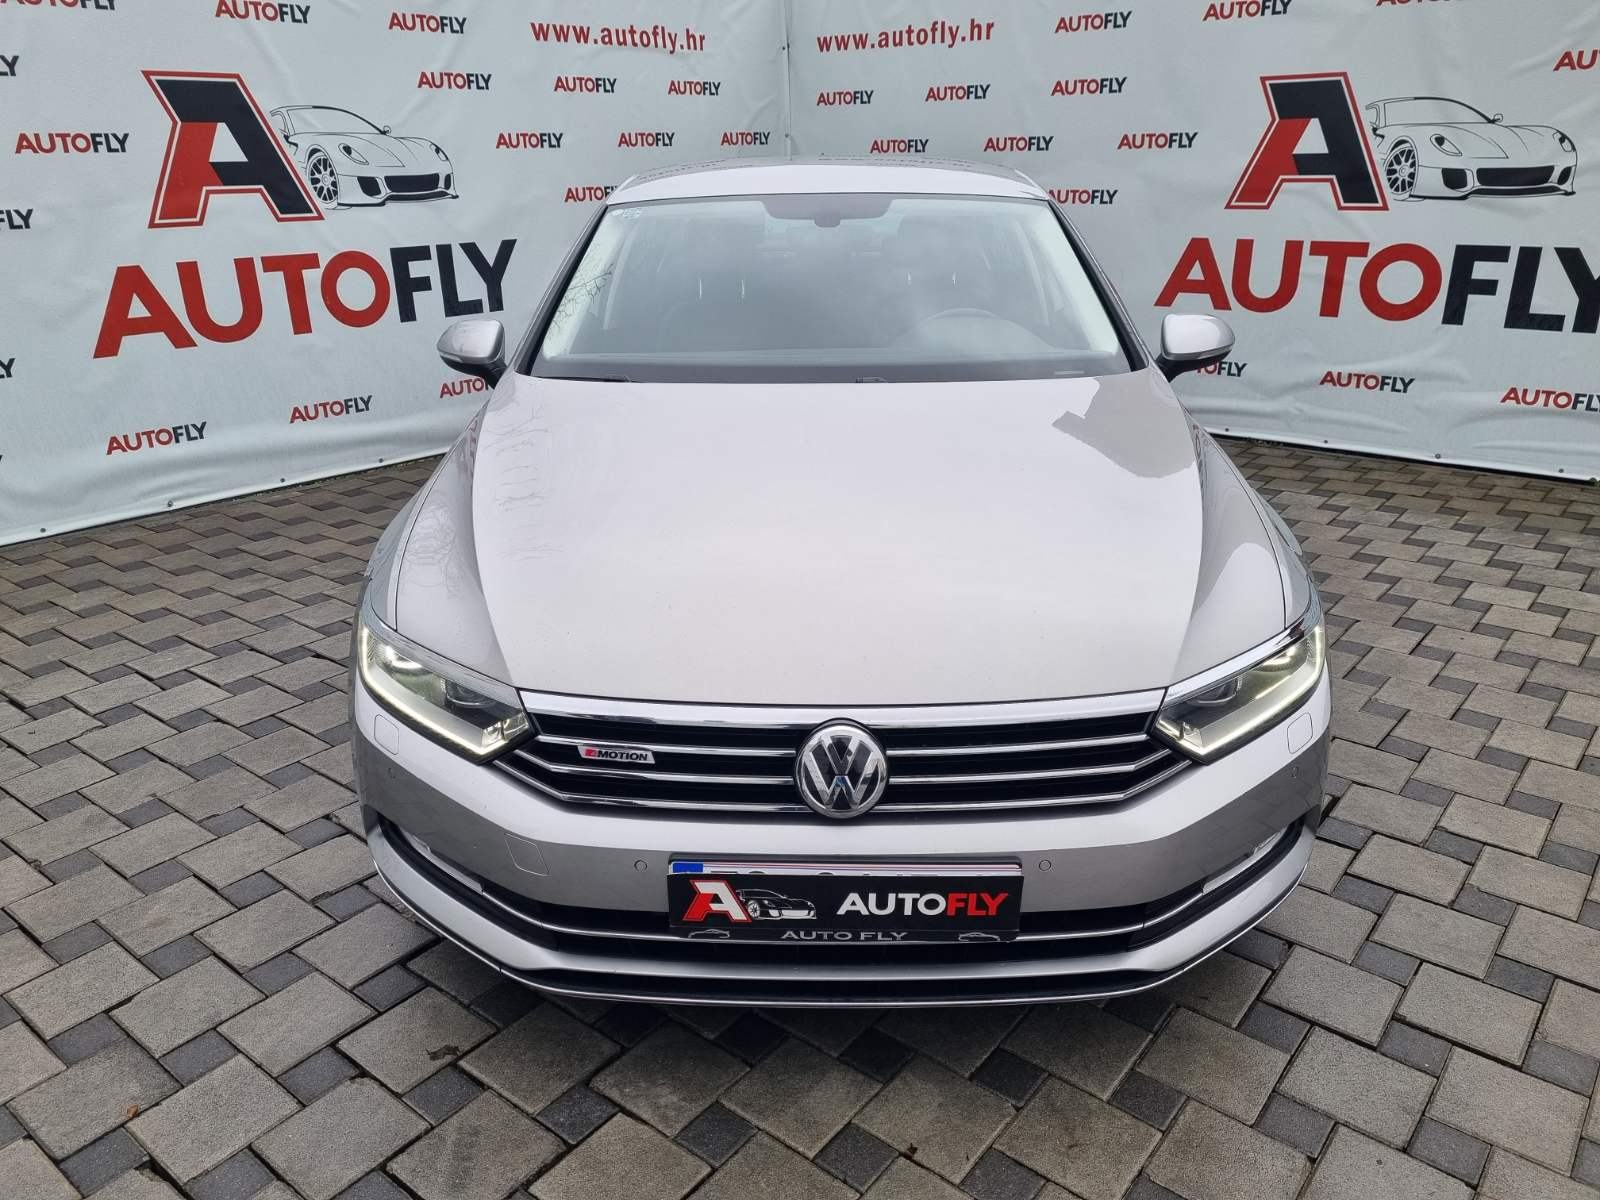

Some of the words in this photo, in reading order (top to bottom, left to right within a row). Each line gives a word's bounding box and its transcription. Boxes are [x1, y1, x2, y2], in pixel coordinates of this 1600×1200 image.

[215, 0, 311, 24] AUTOFLY
[1203, 0, 1292, 21] AUTOFLY
[389, 12, 467, 35] AUTOFLY
[1055, 11, 1132, 33] AUTOFLY
[530, 22, 706, 54] www.autofly.hr
[817, 18, 995, 53] www.autofly.hr
[1553, 49, 1600, 72] AU
[418, 71, 493, 91] AUTOFLY
[554, 75, 618, 94] AUTOFLY
[668, 80, 721, 97] AUTOFLY
[1051, 77, 1128, 97] AUTOFLY
[817, 90, 875, 107] AUTOFLY
[925, 84, 991, 102] AUTOFLY
[15, 133, 130, 155] AUTOFLY
[496, 132, 564, 150] AUTOFLY
[618, 132, 676, 148] AUTOFLY
[721, 132, 771, 147] AUTOFLY
[870, 139, 930, 154] AUTOFLY
[984, 136, 1055, 153] AUTOFLY
[1117, 132, 1199, 150] AUTOFLY
[565, 185, 618, 203] AUTOF
[1154, 237, 1600, 335] AUTOFLY
[93, 239, 518, 359] AUTOFLY
[1319, 371, 1416, 394] AUTOFLY
[290, 395, 373, 424] AUTOFLY
[1500, 387, 1600, 413] AUTOFL
[107, 421, 207, 456] AUTOFLY
[836, 892, 1009, 917] AUTOFLY
[781, 930, 853, 941] AUTO
[860, 931, 908, 941] FLY
